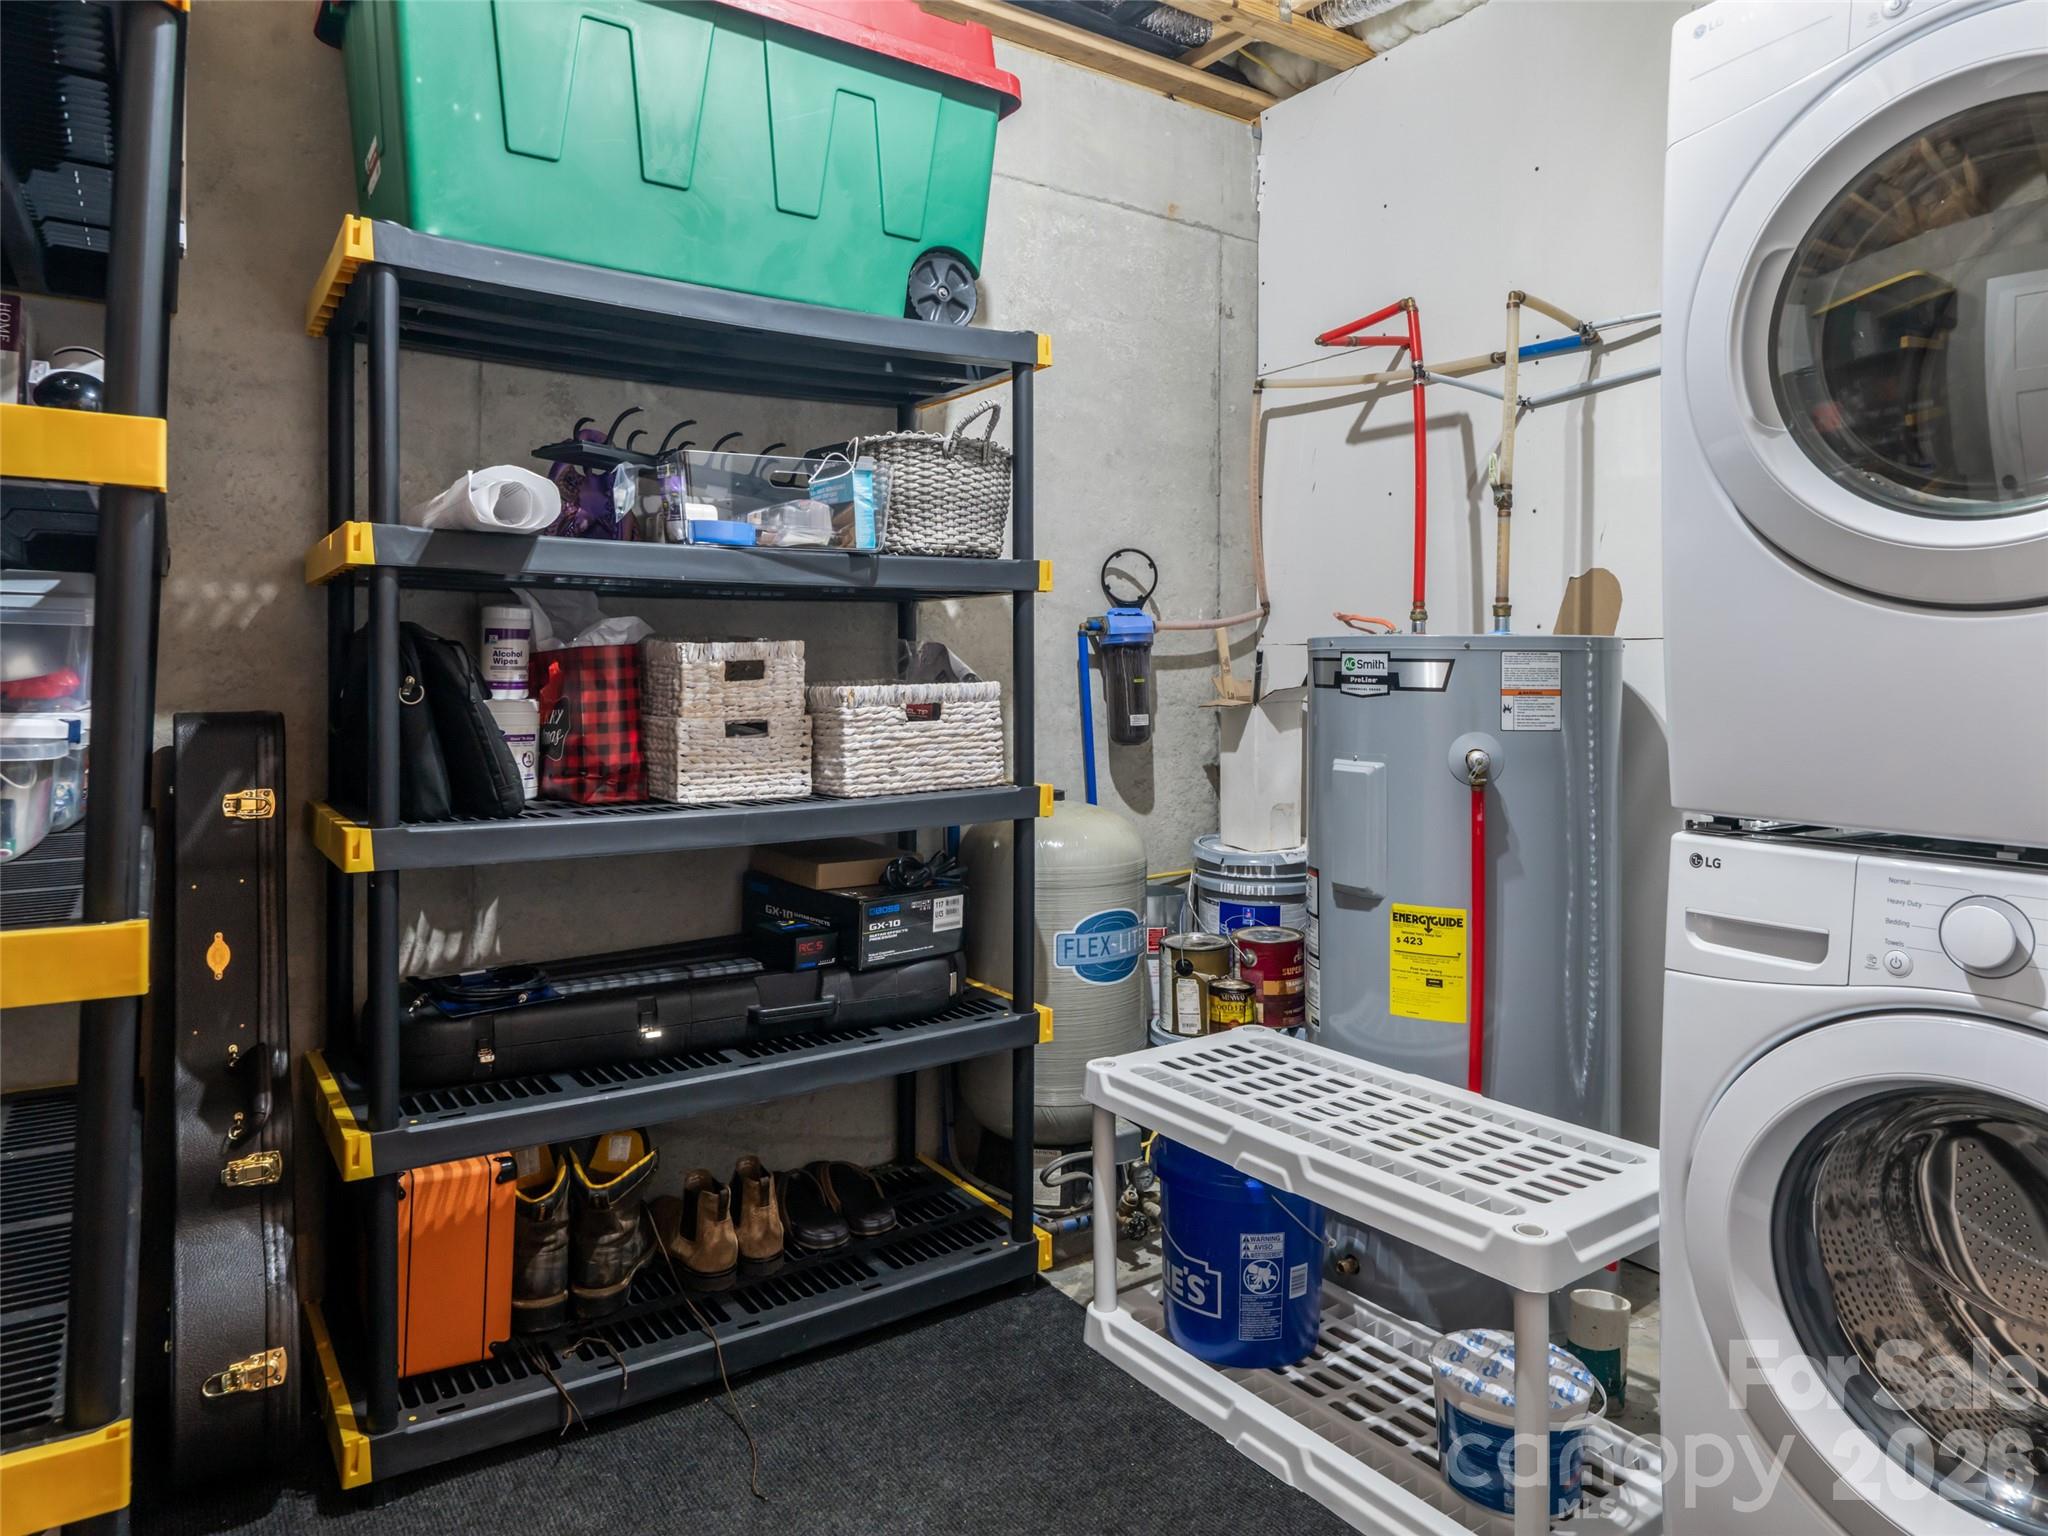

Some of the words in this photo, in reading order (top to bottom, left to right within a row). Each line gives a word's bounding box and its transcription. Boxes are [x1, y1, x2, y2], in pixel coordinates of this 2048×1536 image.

[0, 302, 11, 342] HOME
[493, 650, 523, 658] Alcohol
[493, 658, 518, 666] Wipes
[1357, 659, 1386, 669] Smith
[1705, 858, 1721, 869] LG
[1889, 877, 1911, 885] Normal
[1887, 897, 1906, 908] Heavy
[1907, 900, 1922, 909] Duty
[765, 904, 793, 919] GX-10
[868, 904, 900, 916] BOSS
[869, 920, 900, 931] GX-10
[1885, 918, 1910, 929] Bedding
[1403, 935, 1424, 946] 423
[1885, 938, 1905, 947] Towels
